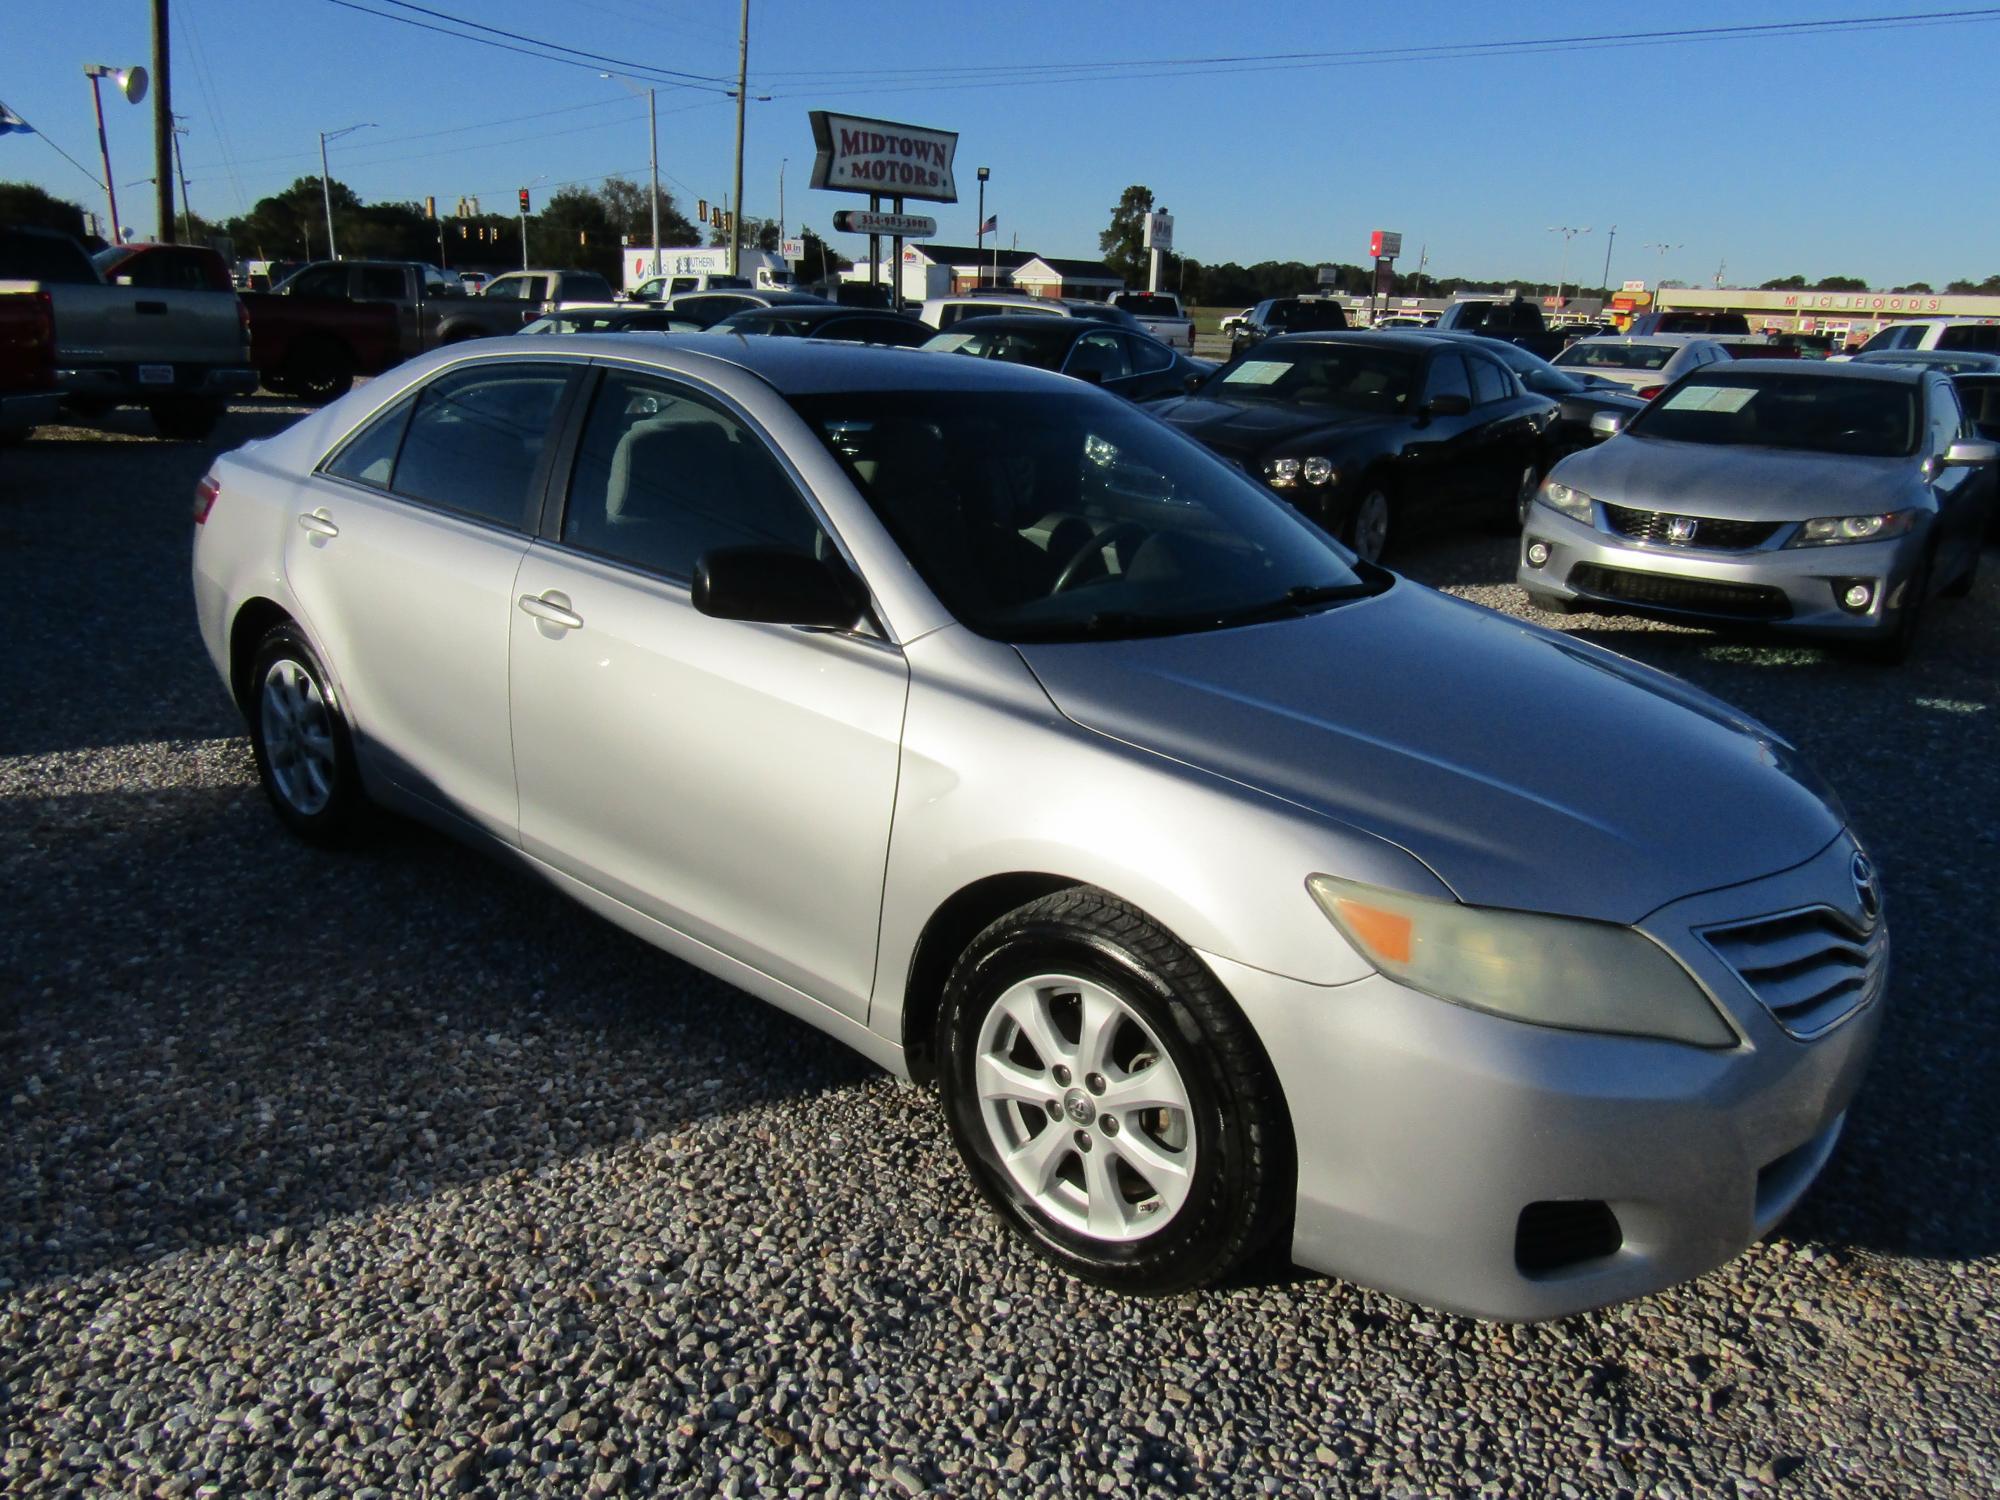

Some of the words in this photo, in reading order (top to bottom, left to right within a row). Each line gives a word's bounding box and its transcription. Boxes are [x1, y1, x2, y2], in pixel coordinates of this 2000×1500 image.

[840, 128, 947, 170] MIDTOWN
[851, 160, 939, 187] MOTORS
[1855, 298, 1938, 311] FOODS
